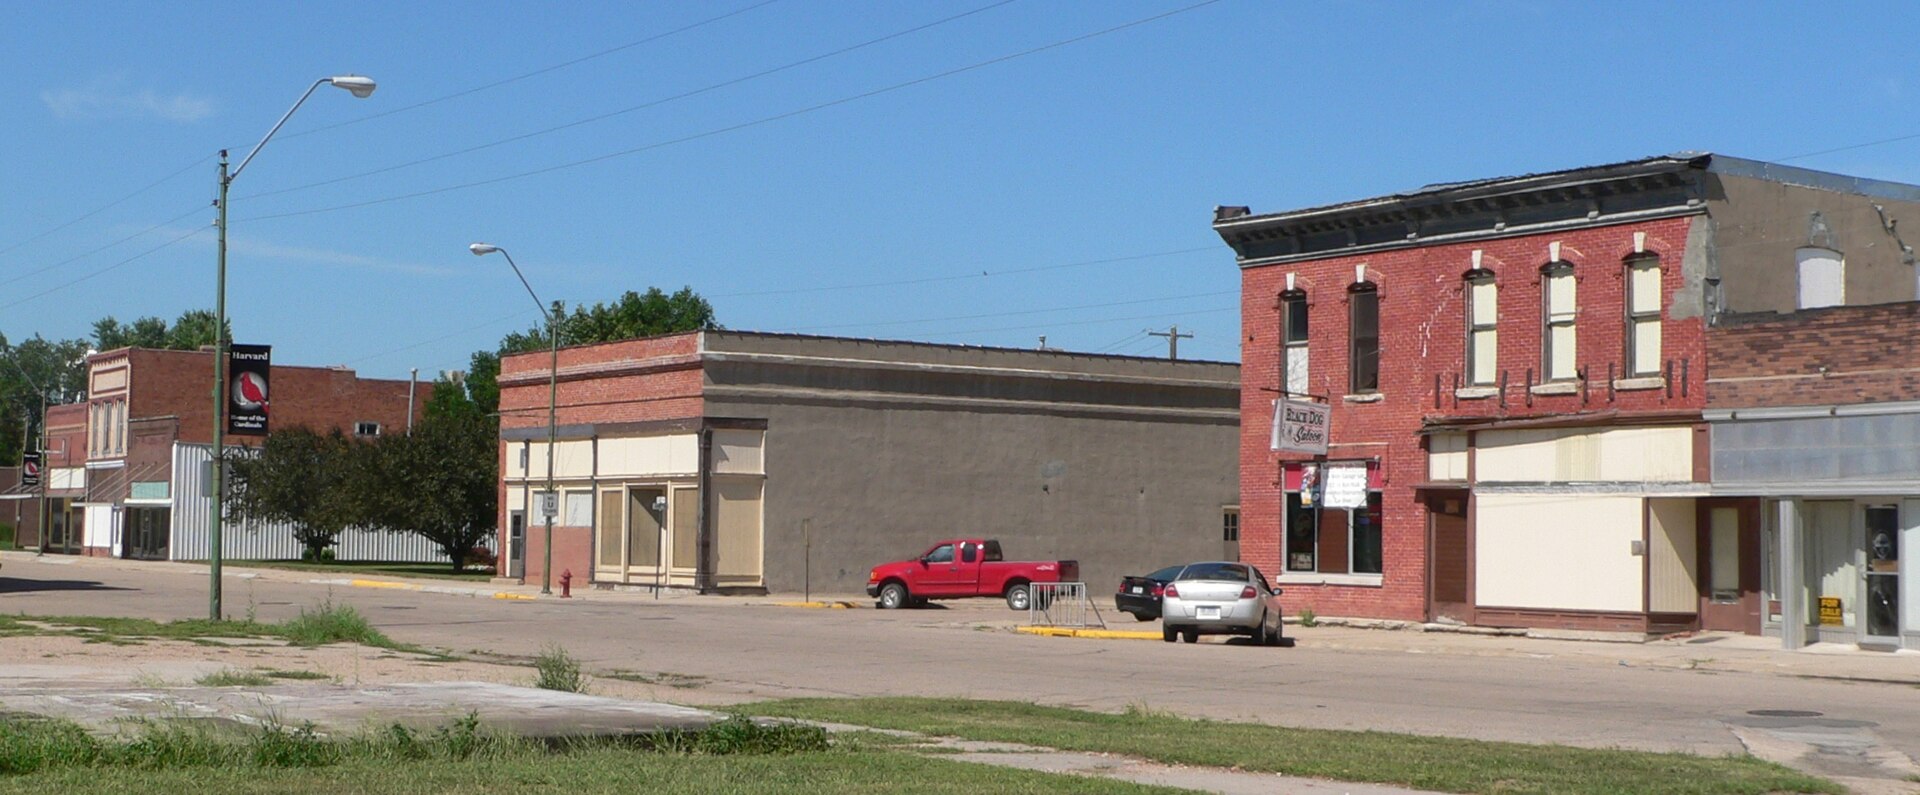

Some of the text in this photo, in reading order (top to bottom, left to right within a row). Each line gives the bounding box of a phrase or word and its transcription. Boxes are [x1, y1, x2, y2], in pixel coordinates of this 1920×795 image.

[232, 351, 268, 360] Harvard
[1309, 410, 1324, 425] DOG
[1821, 599, 1838, 608] FOR
[1821, 607, 1840, 616] SALE
